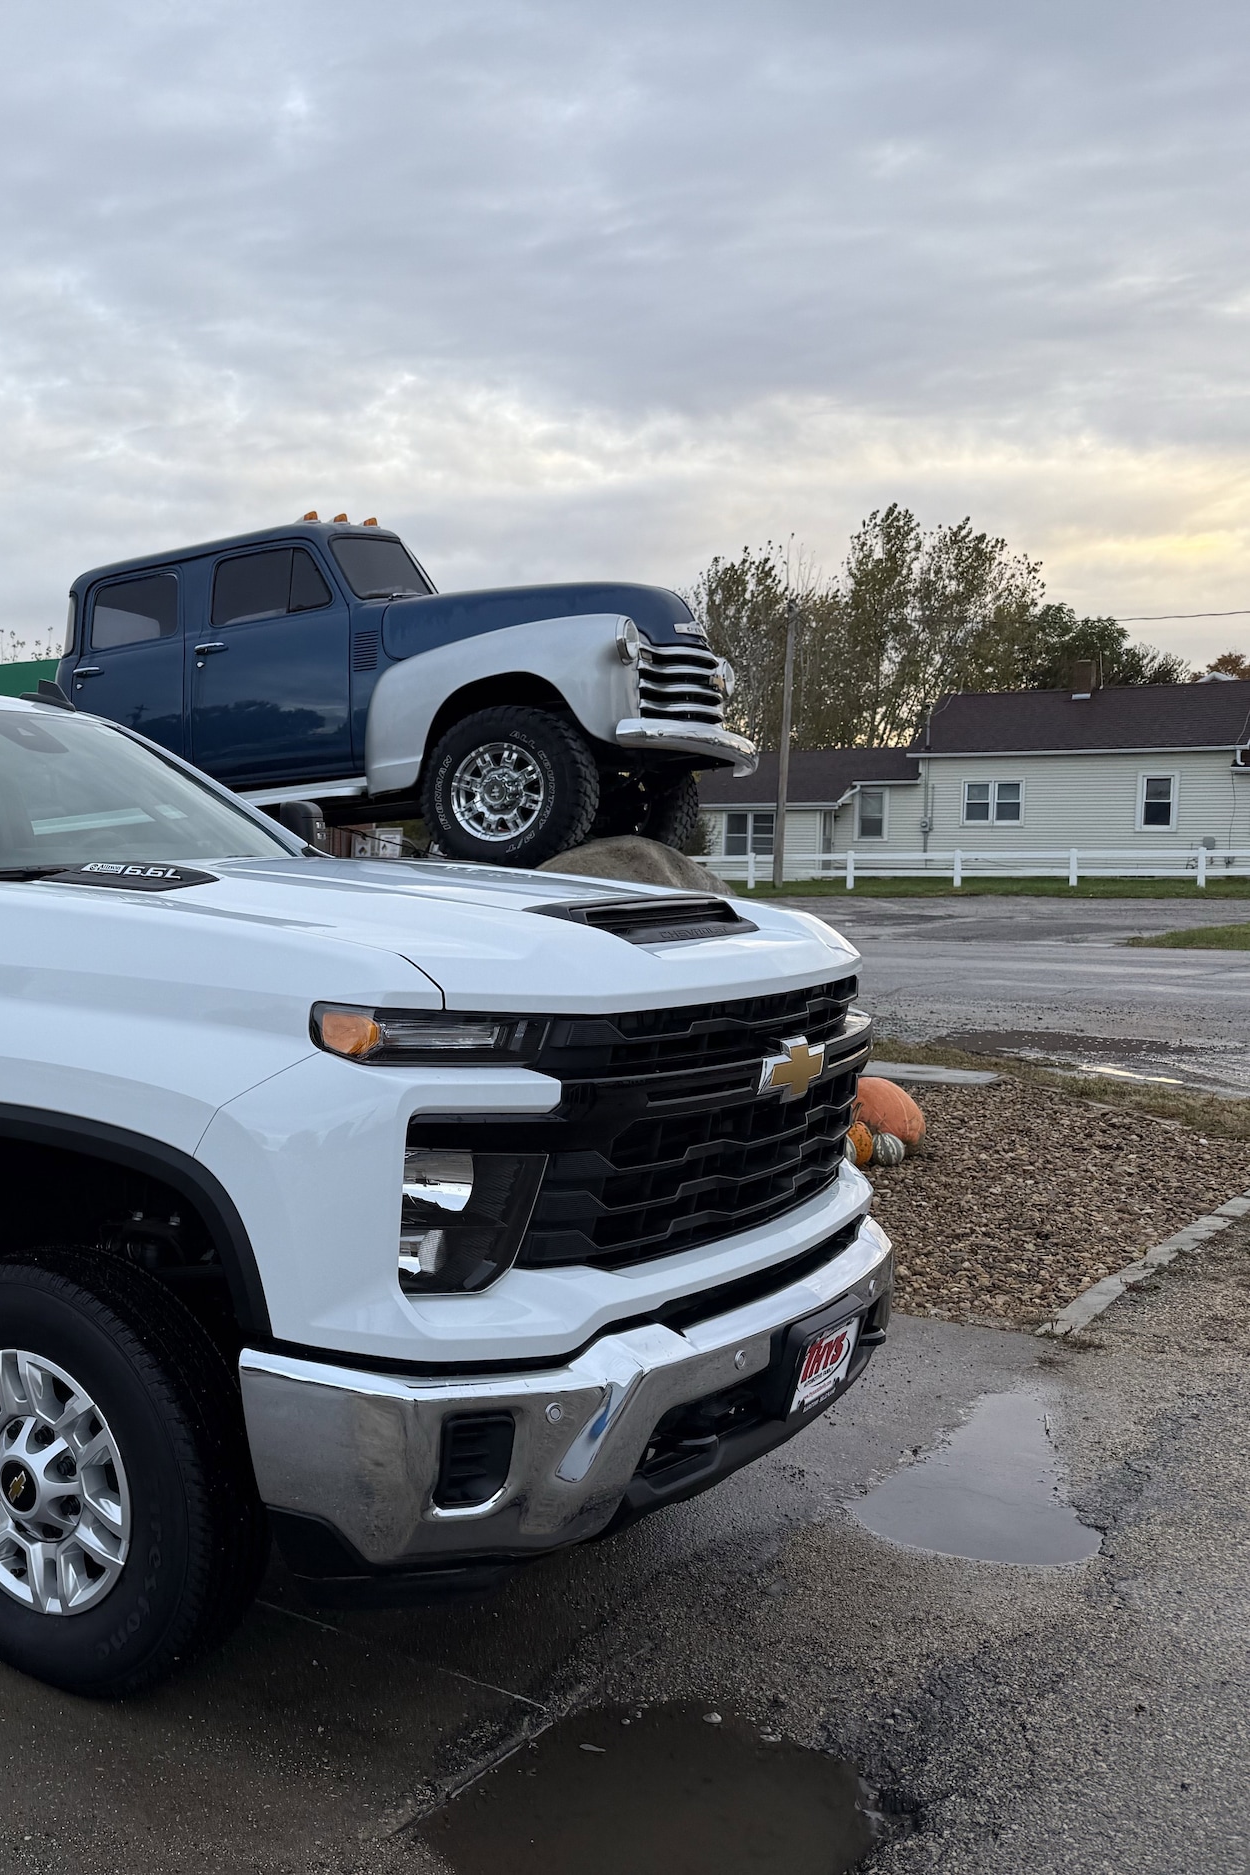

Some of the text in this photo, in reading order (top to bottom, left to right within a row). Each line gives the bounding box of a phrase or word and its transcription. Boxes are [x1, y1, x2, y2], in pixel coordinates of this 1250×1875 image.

[434, 754, 453, 831] IRONMAN
[509, 730, 536, 750] ALL
[537, 750, 556, 830] COUNTRY
[123, 865, 183, 880] 6.6L
[658, 926, 728, 939] CHEVROLET
[800, 1330, 848, 1383] THYS
